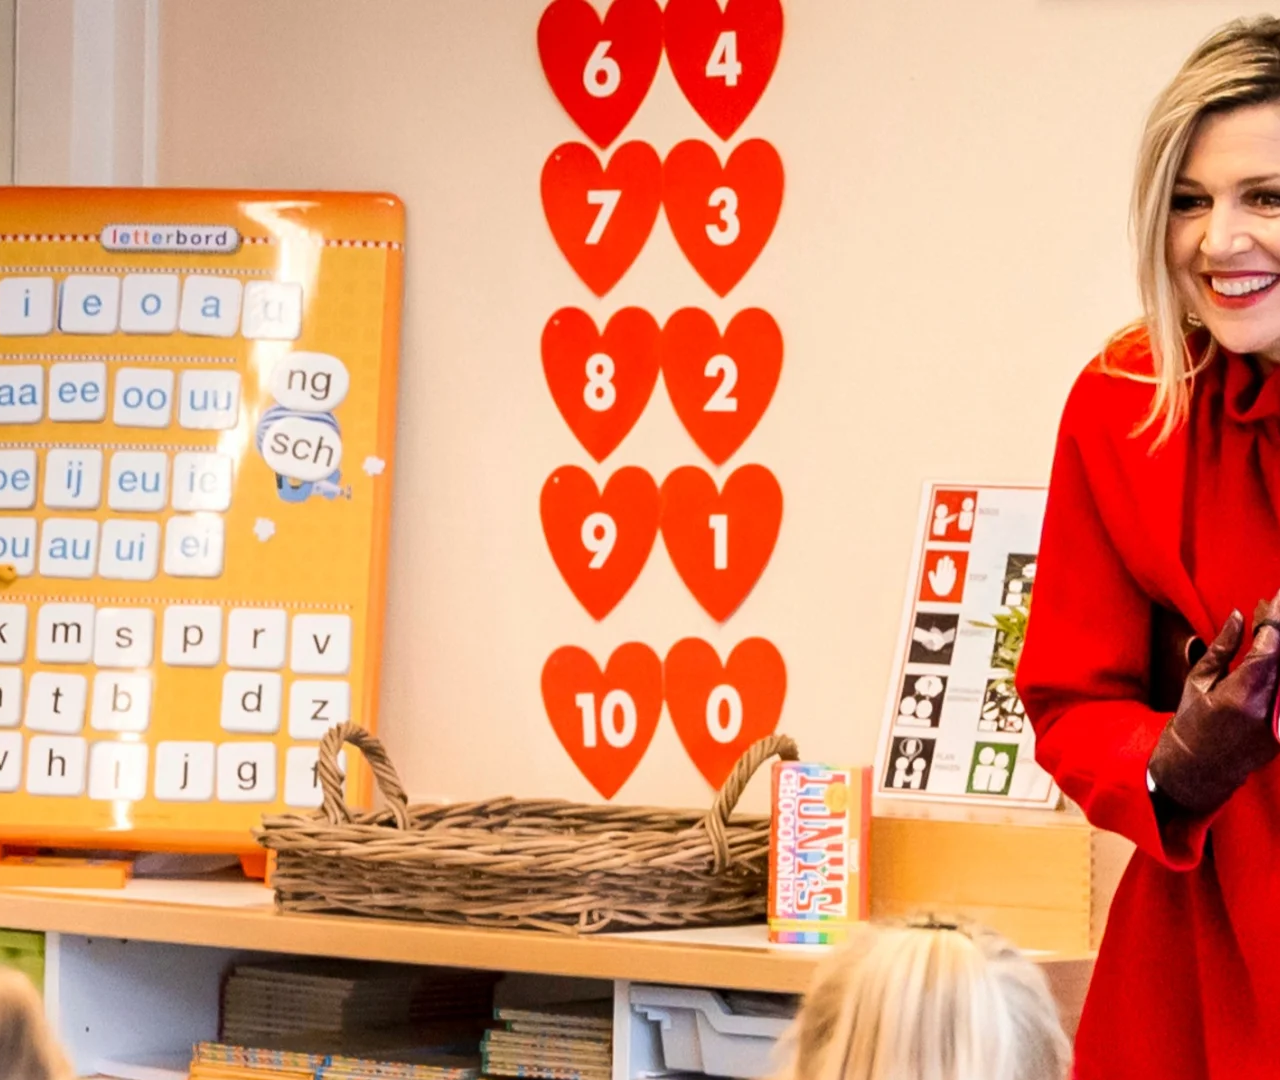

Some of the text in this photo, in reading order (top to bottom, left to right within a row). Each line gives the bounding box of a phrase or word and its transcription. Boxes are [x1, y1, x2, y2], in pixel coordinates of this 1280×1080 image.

[583, 31, 741, 97] 6 4
[585, 187, 740, 245] 7 3
[110, 229, 227, 249] letterbord
[23, 289, 30, 318] i
[82, 295, 102, 316] e
[141, 294, 161, 315] o
[201, 296, 220, 318] a
[58, 382, 99, 403] ee
[123, 387, 167, 410] oo
[190, 389, 232, 412] uu
[288, 371, 331, 400] ng
[584, 353, 737, 411] 8 2
[270, 428, 334, 468] sch
[67, 461, 83, 498] ij
[118, 471, 159, 492] eu
[49, 538, 90, 560] au
[116, 534, 144, 561] ui
[581, 513, 727, 569] 9 1
[52, 623, 81, 643] m
[116, 627, 132, 648] s
[183, 626, 203, 653] p
[253, 629, 264, 648] r
[313, 634, 330, 654] v
[52, 687, 62, 714] t
[112, 684, 131, 711] b
[242, 685, 262, 712] d
[311, 700, 328, 720] z
[576, 685, 742, 746] 10 0
[48, 749, 65, 776] h
[181, 754, 188, 789] j
[238, 762, 257, 790] g
